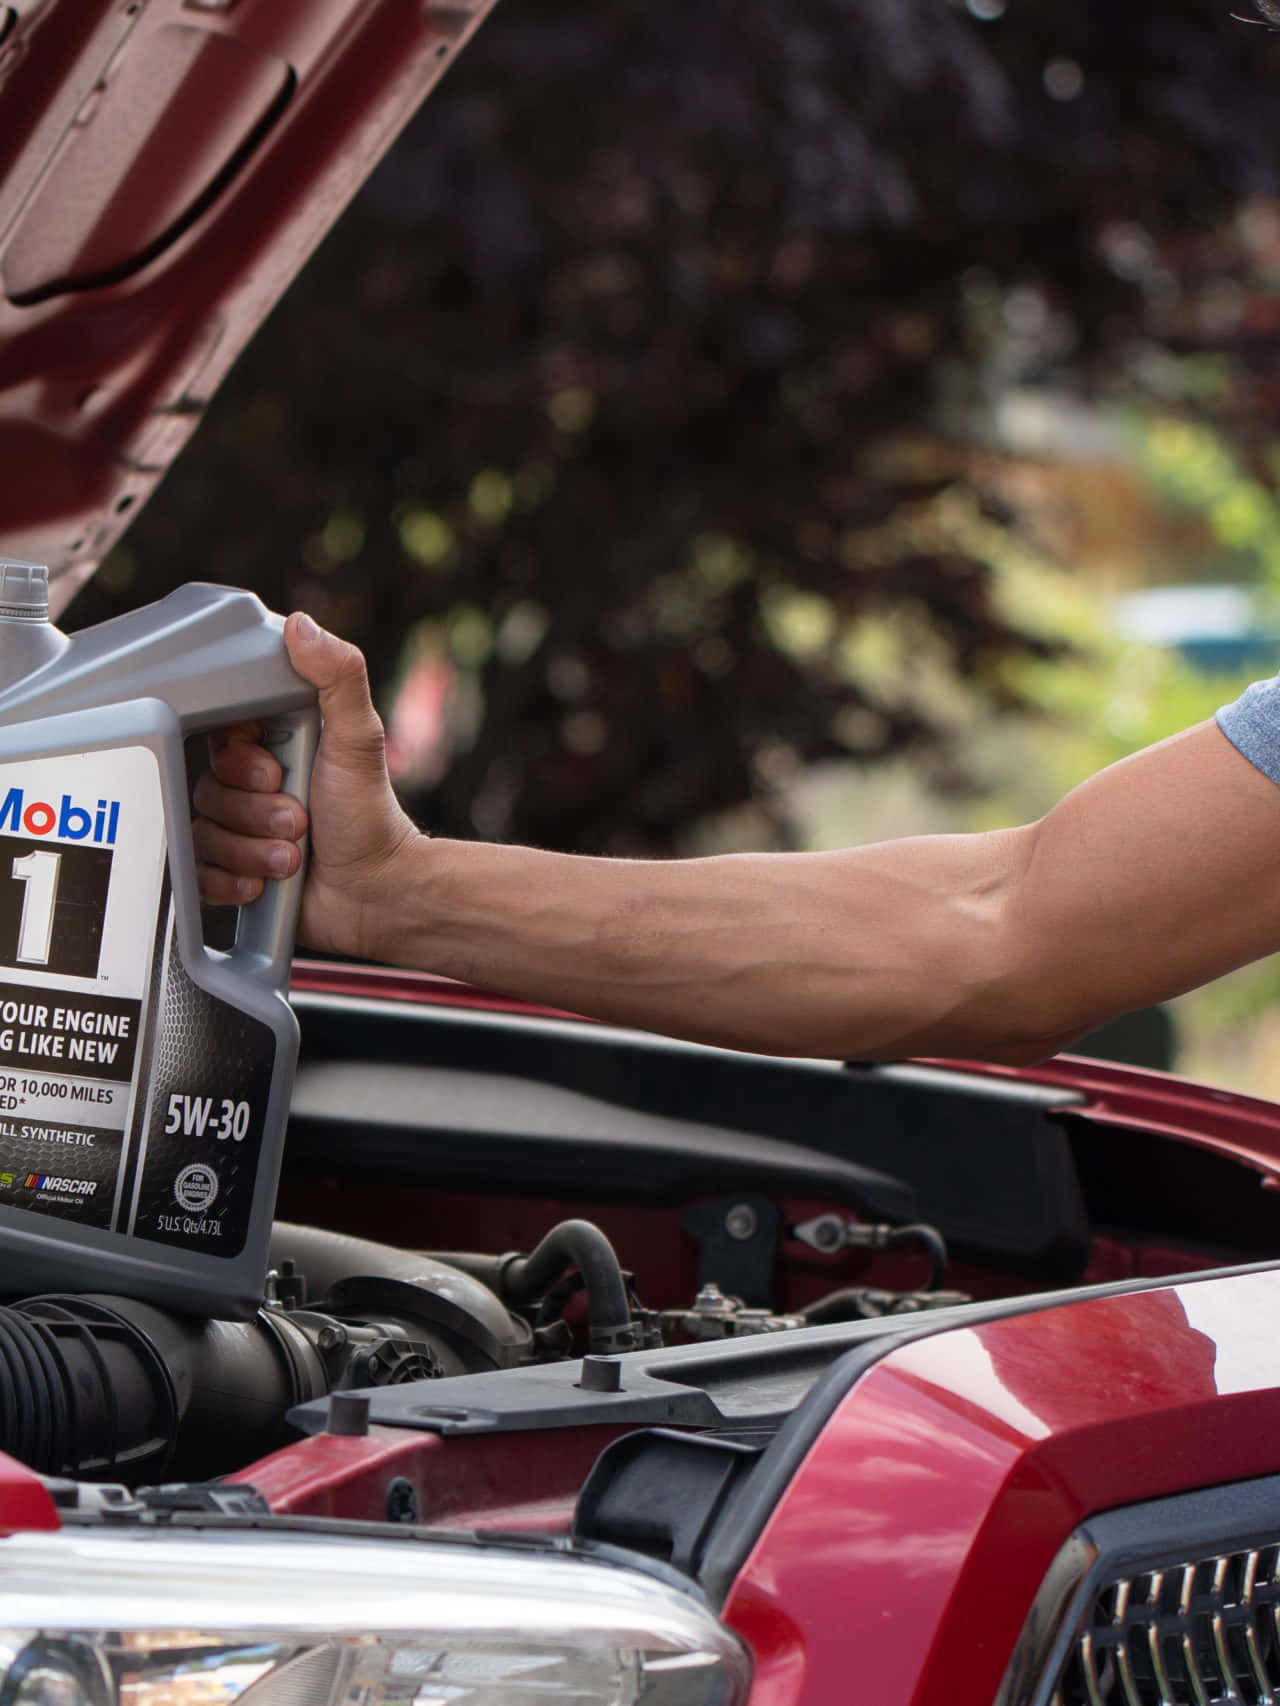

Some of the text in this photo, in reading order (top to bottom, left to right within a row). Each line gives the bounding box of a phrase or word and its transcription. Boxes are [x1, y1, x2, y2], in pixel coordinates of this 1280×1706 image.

[11, 850, 62, 965] 1
[52, 1007, 130, 1038] ENGINE
[18, 1032, 63, 1058] LIKE
[68, 1038, 119, 1064] NEW
[20, 1079, 68, 1100] 10,000
[70, 1086, 114, 1105] MILES
[165, 1094, 250, 1142] 5W-30
[20, 1125, 96, 1147] SYNTHETIC
[41, 1175, 97, 1195] NASCAR
[192, 1174, 205, 1182] FOR
[157, 1215, 164, 1230] 5
[165, 1215, 181, 1232] U.S.
